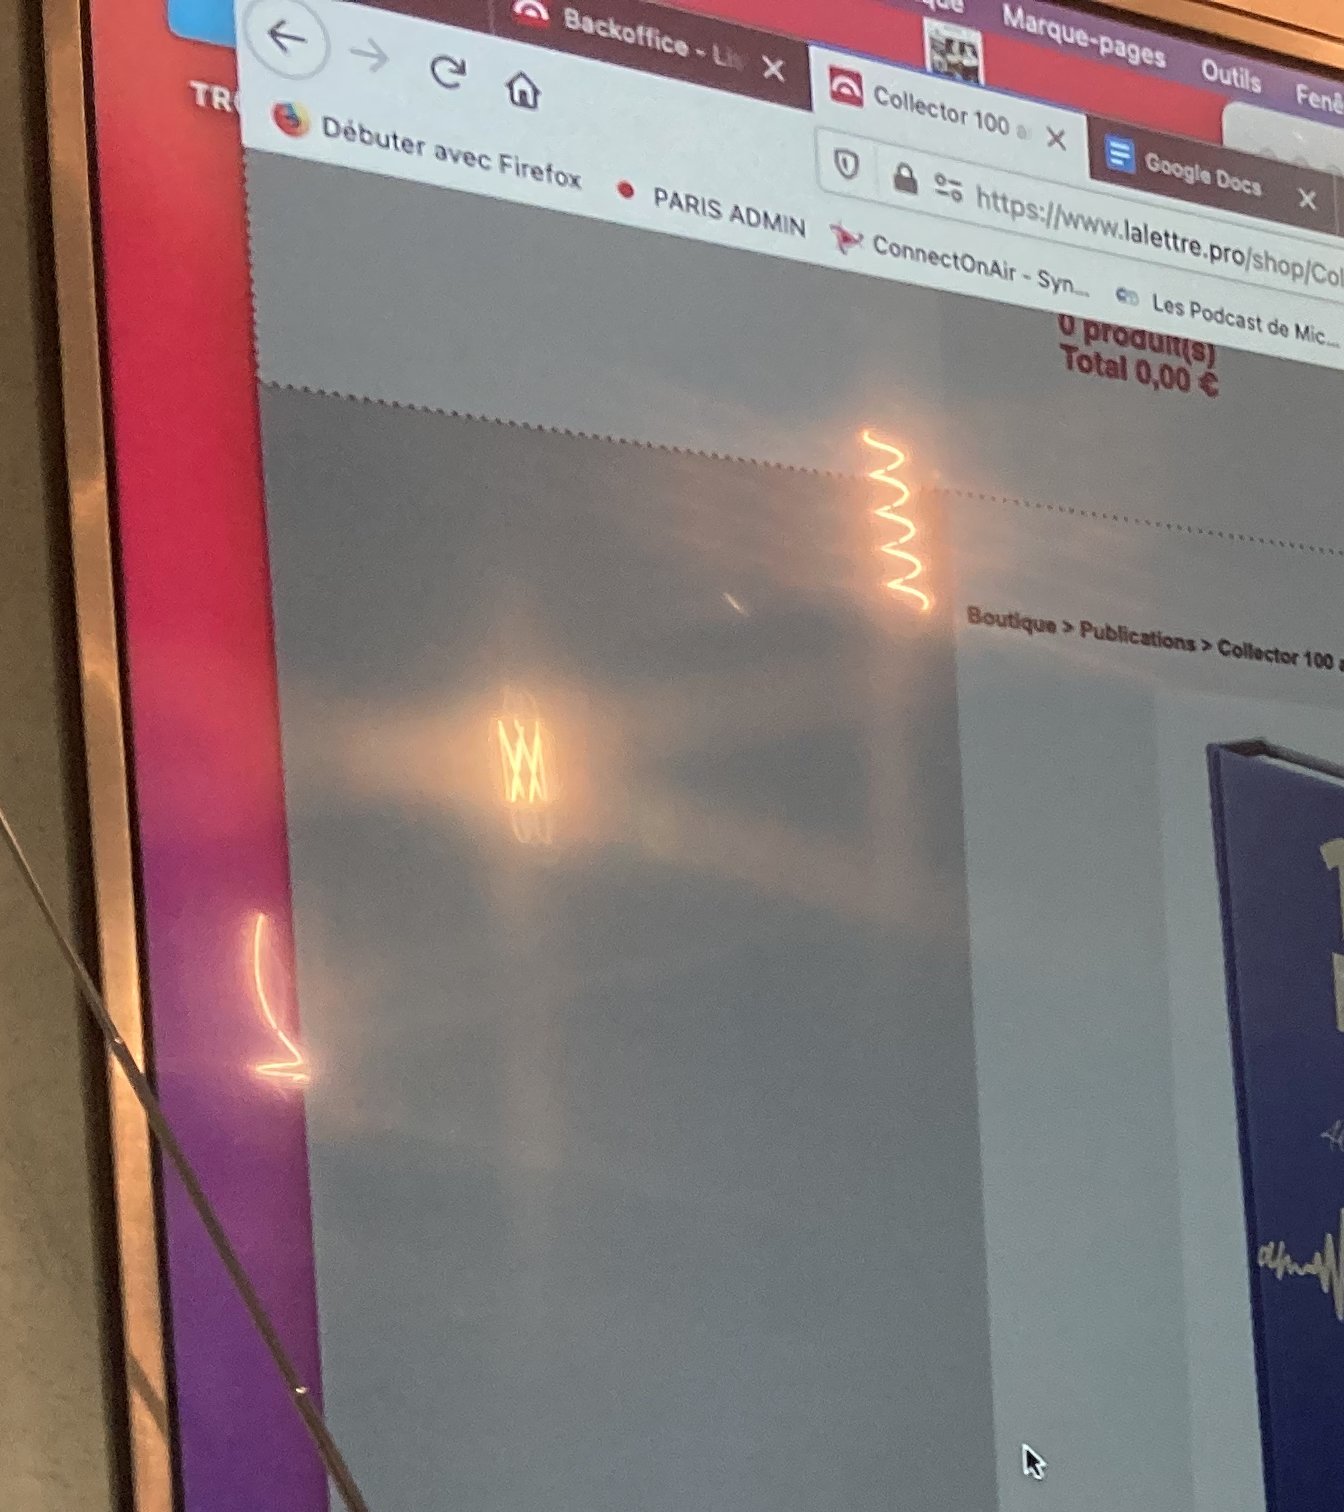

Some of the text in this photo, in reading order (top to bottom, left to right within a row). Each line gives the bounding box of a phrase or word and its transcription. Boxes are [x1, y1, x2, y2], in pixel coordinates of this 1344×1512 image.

[564, 6, 689, 57] Backoffice
[1003, 3, 1167, 69] Marque-pages
[1201, 58, 1261, 94] Outils
[873, 85, 1009, 136] Collector 100
[322, 115, 581, 190] Débuter avec Firefox
[1145, 151, 1262, 197] Google Docs
[655, 187, 806, 238] PARIS ADMIN
[874, 235, 1016, 282] ConnectOnAir
[1153, 294, 1184, 317] Les
[1190, 302, 1262, 334] Podcast
[1267, 320, 1289, 338] de
[1060, 343, 1218, 398] Total 0,00 €
[967, 606, 1057, 635] Boutique
[1079, 620, 1196, 653] Publications
[1217, 638, 1298, 666] Collector
[1304, 651, 1333, 670] 100
